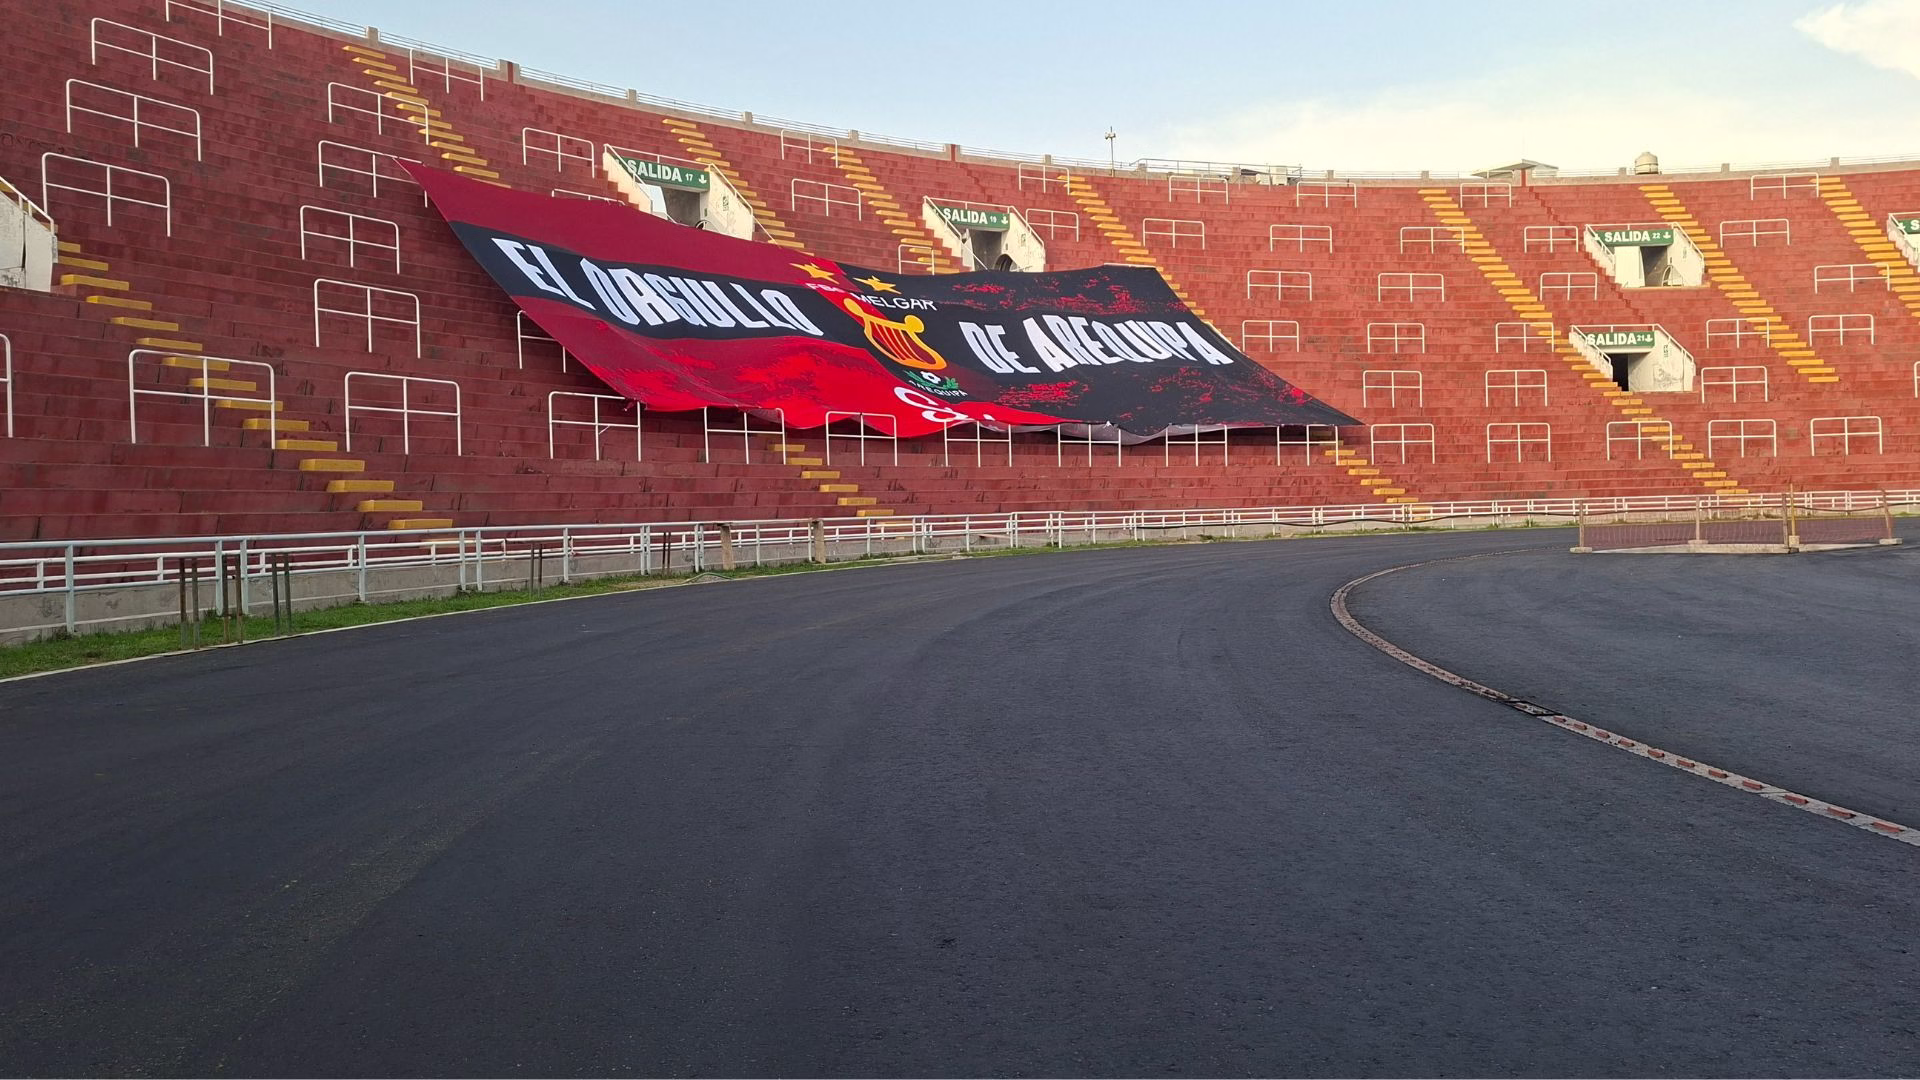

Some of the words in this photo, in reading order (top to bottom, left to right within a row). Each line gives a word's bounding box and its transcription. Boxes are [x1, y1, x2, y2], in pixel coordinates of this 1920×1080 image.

[627, 159, 683, 183] SALIDA
[685, 173, 694, 182] 17
[943, 208, 988, 224] SALIDA
[1604, 230, 1651, 243] SALIDA
[491, 237, 597, 311] EL
[579, 257, 825, 337] ORGULLO
[849, 292, 938, 312] MELGAR
[958, 321, 1042, 374] DE
[1022, 314, 1235, 373] AREQUIPA
[1586, 332, 1638, 346] SALIDA
[1637, 334, 1645, 342] 21
